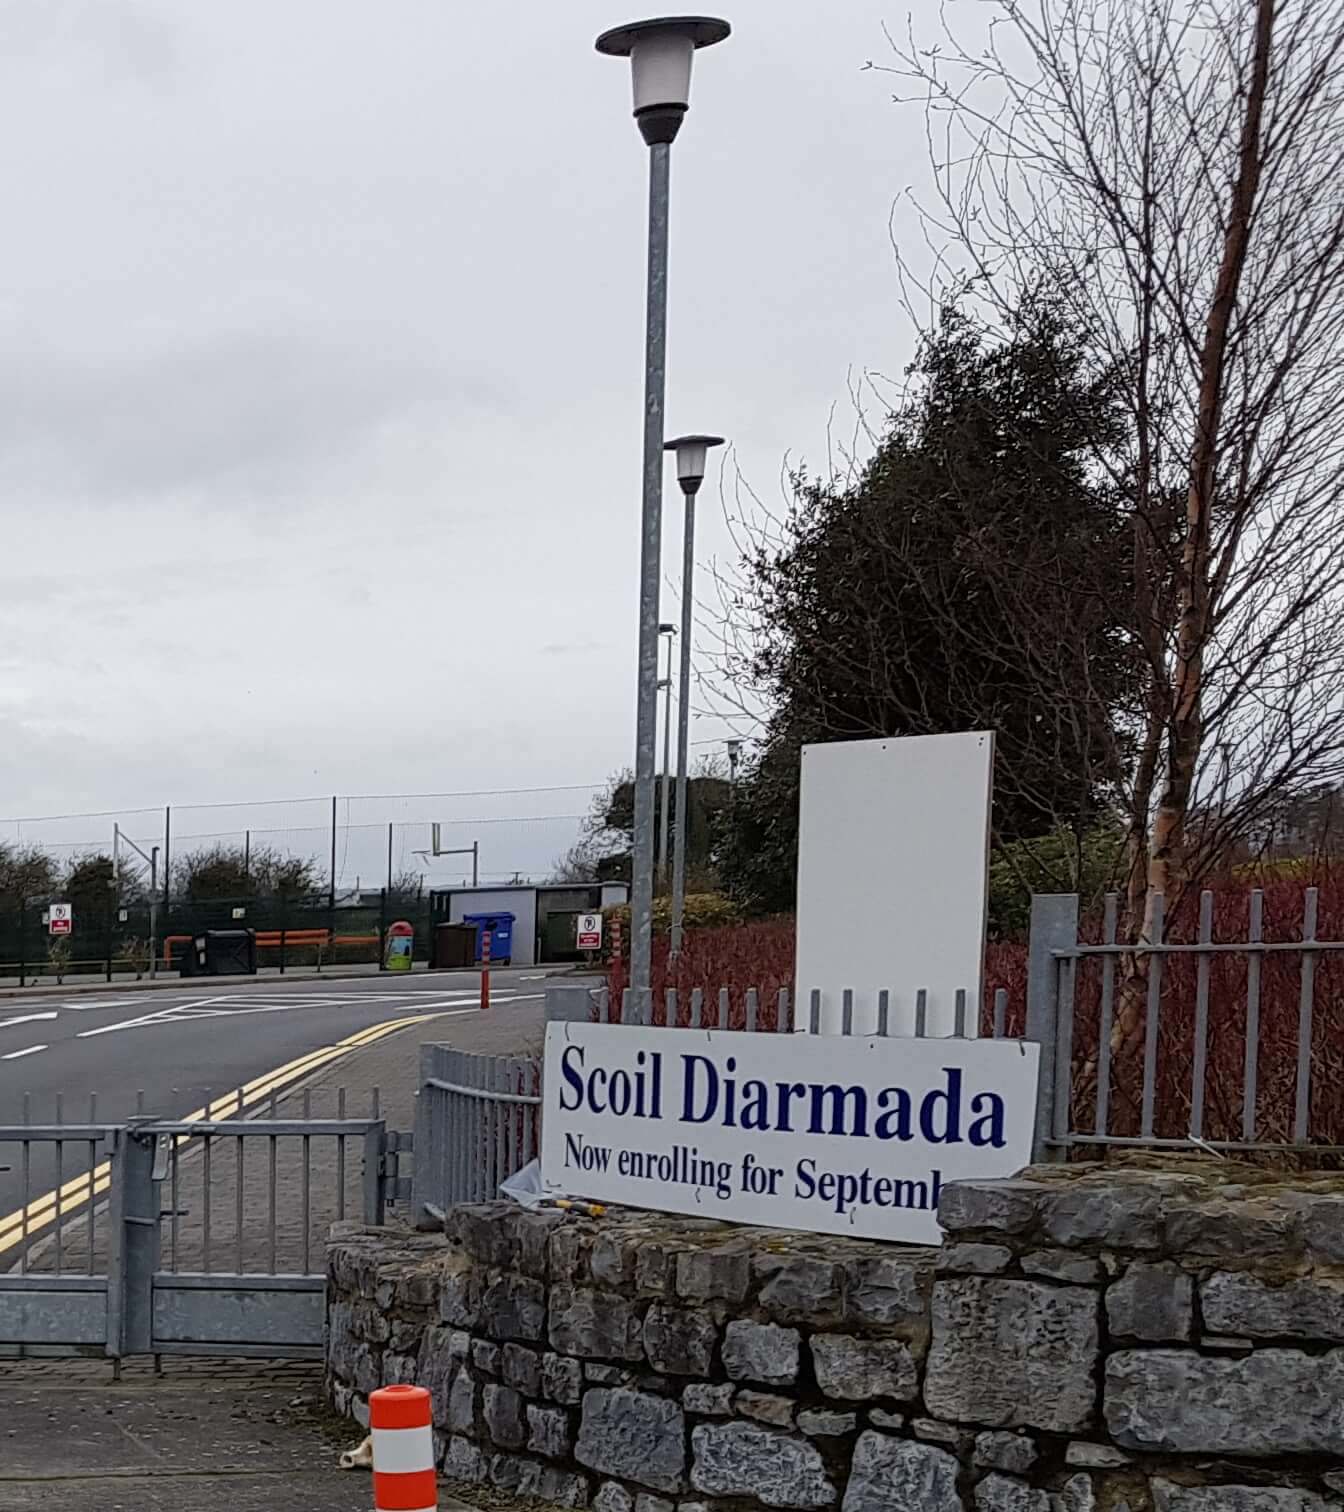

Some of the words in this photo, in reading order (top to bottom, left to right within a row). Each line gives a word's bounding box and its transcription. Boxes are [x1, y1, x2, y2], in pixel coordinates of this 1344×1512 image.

[559, 1045, 663, 1120] Scoil
[678, 1054, 1008, 1149] Diarmada
[564, 1133, 613, 1173] Now
[617, 1145, 733, 1201] enrolling
[740, 1153, 784, 1196] for
